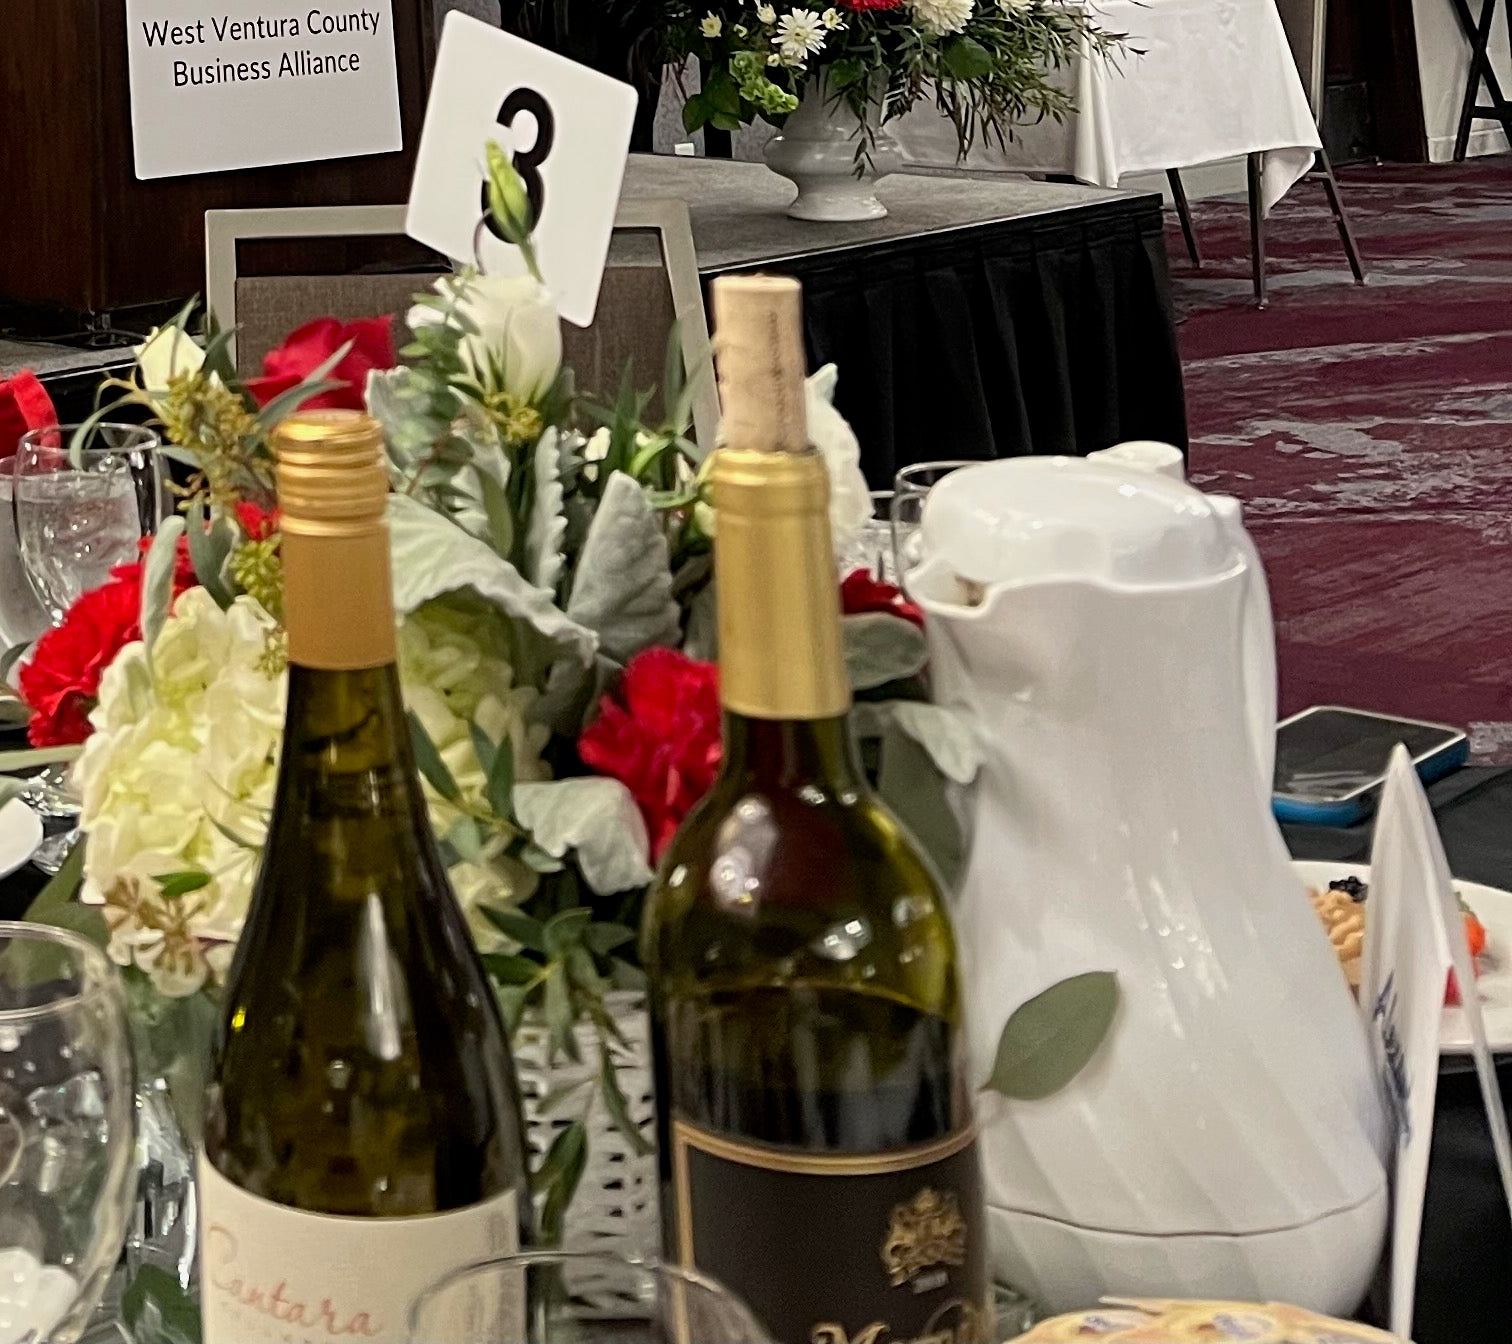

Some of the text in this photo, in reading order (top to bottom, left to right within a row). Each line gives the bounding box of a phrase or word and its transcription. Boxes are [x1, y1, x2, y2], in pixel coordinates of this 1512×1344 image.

[141, 8, 380, 48] West Ventura County
[173, 50, 360, 87] Business Alliance
[481, 86, 556, 245] 3
